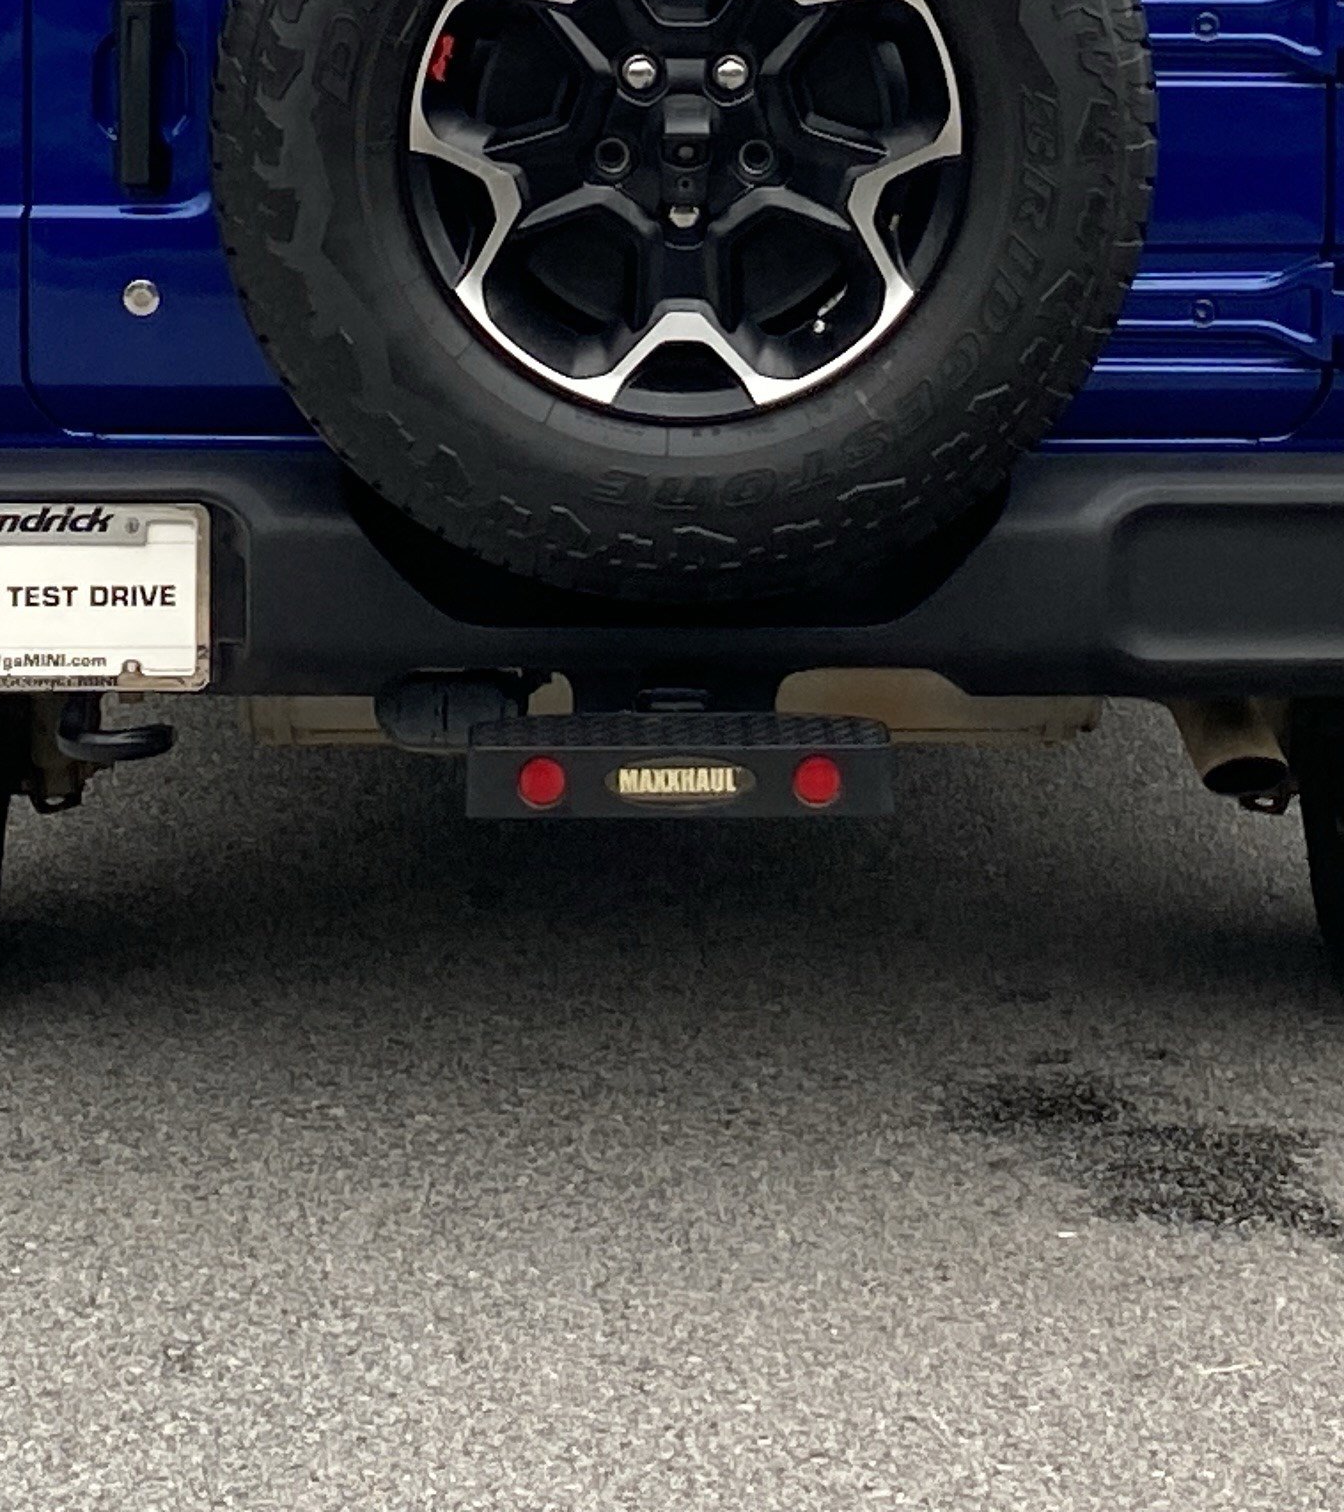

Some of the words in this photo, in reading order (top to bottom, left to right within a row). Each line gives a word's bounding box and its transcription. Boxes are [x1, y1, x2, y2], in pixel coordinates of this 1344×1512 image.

[584, 82, 1070, 513] BRIDGESTONE
[7, 586, 78, 607] TEST
[90, 585, 176, 607] DRIVE
[619, 767, 737, 793] MAXXHAUL
